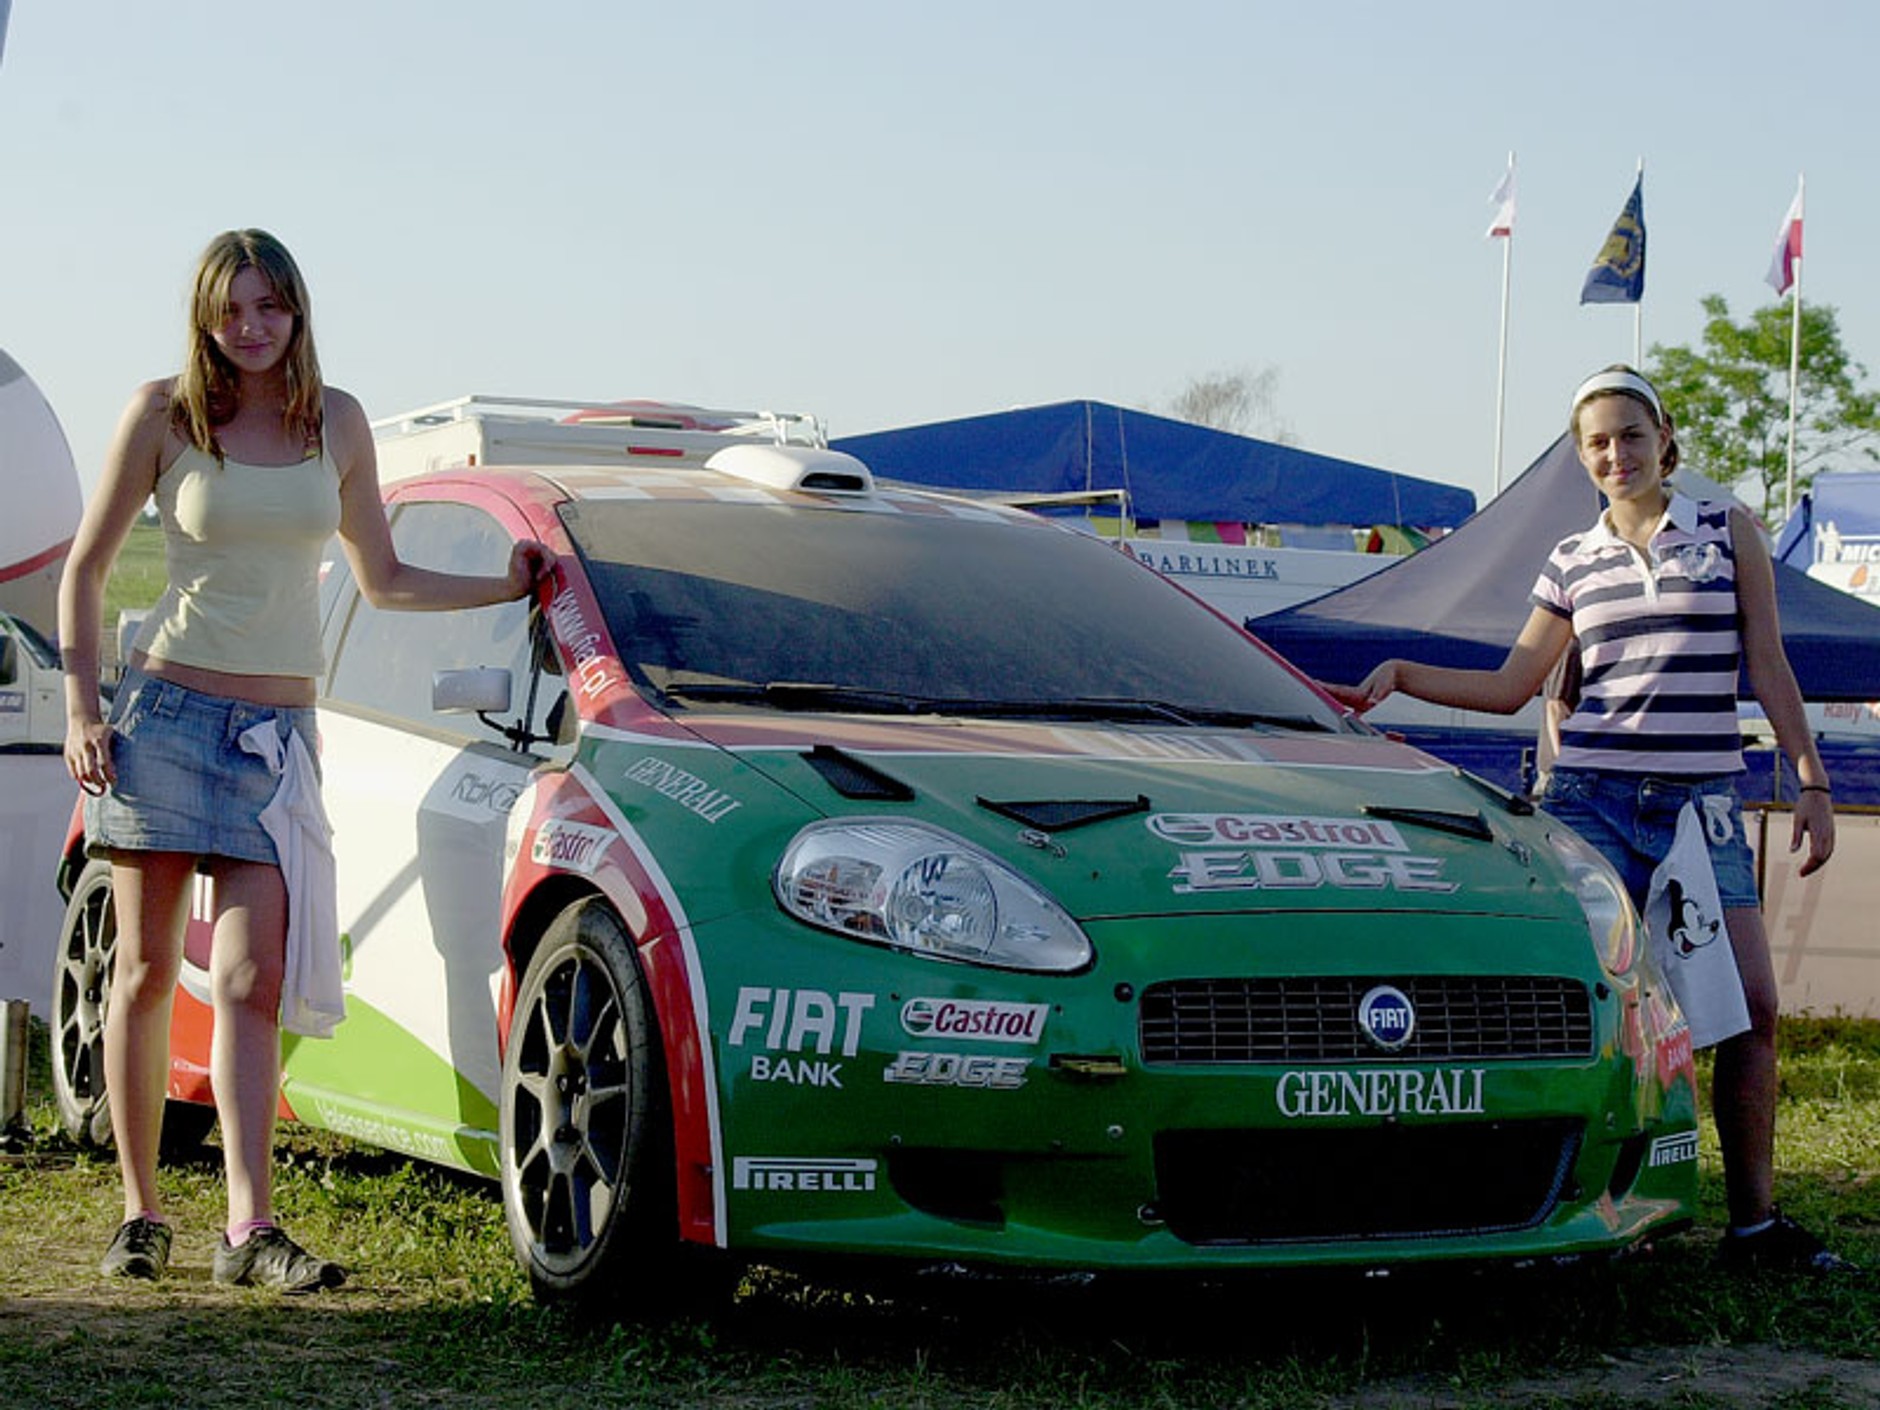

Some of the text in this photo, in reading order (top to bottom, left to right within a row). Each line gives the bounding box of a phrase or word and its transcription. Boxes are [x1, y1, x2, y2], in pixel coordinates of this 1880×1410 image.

[546, 586, 618, 701] www.fiat.pl
[624, 756, 742, 824] GENERALI
[1214, 817, 1394, 847] Castrol
[1167, 850, 1460, 894] EDGE
[728, 986, 876, 1058] FIAT
[935, 1003, 1037, 1037] Castrol
[1369, 1008, 1407, 1029] FIAT
[752, 1055, 844, 1089] BANK
[884, 1050, 1035, 1089] EDGE
[1276, 1067, 1486, 1118] GENERALI
[733, 1156, 878, 1191] PIRELLI
